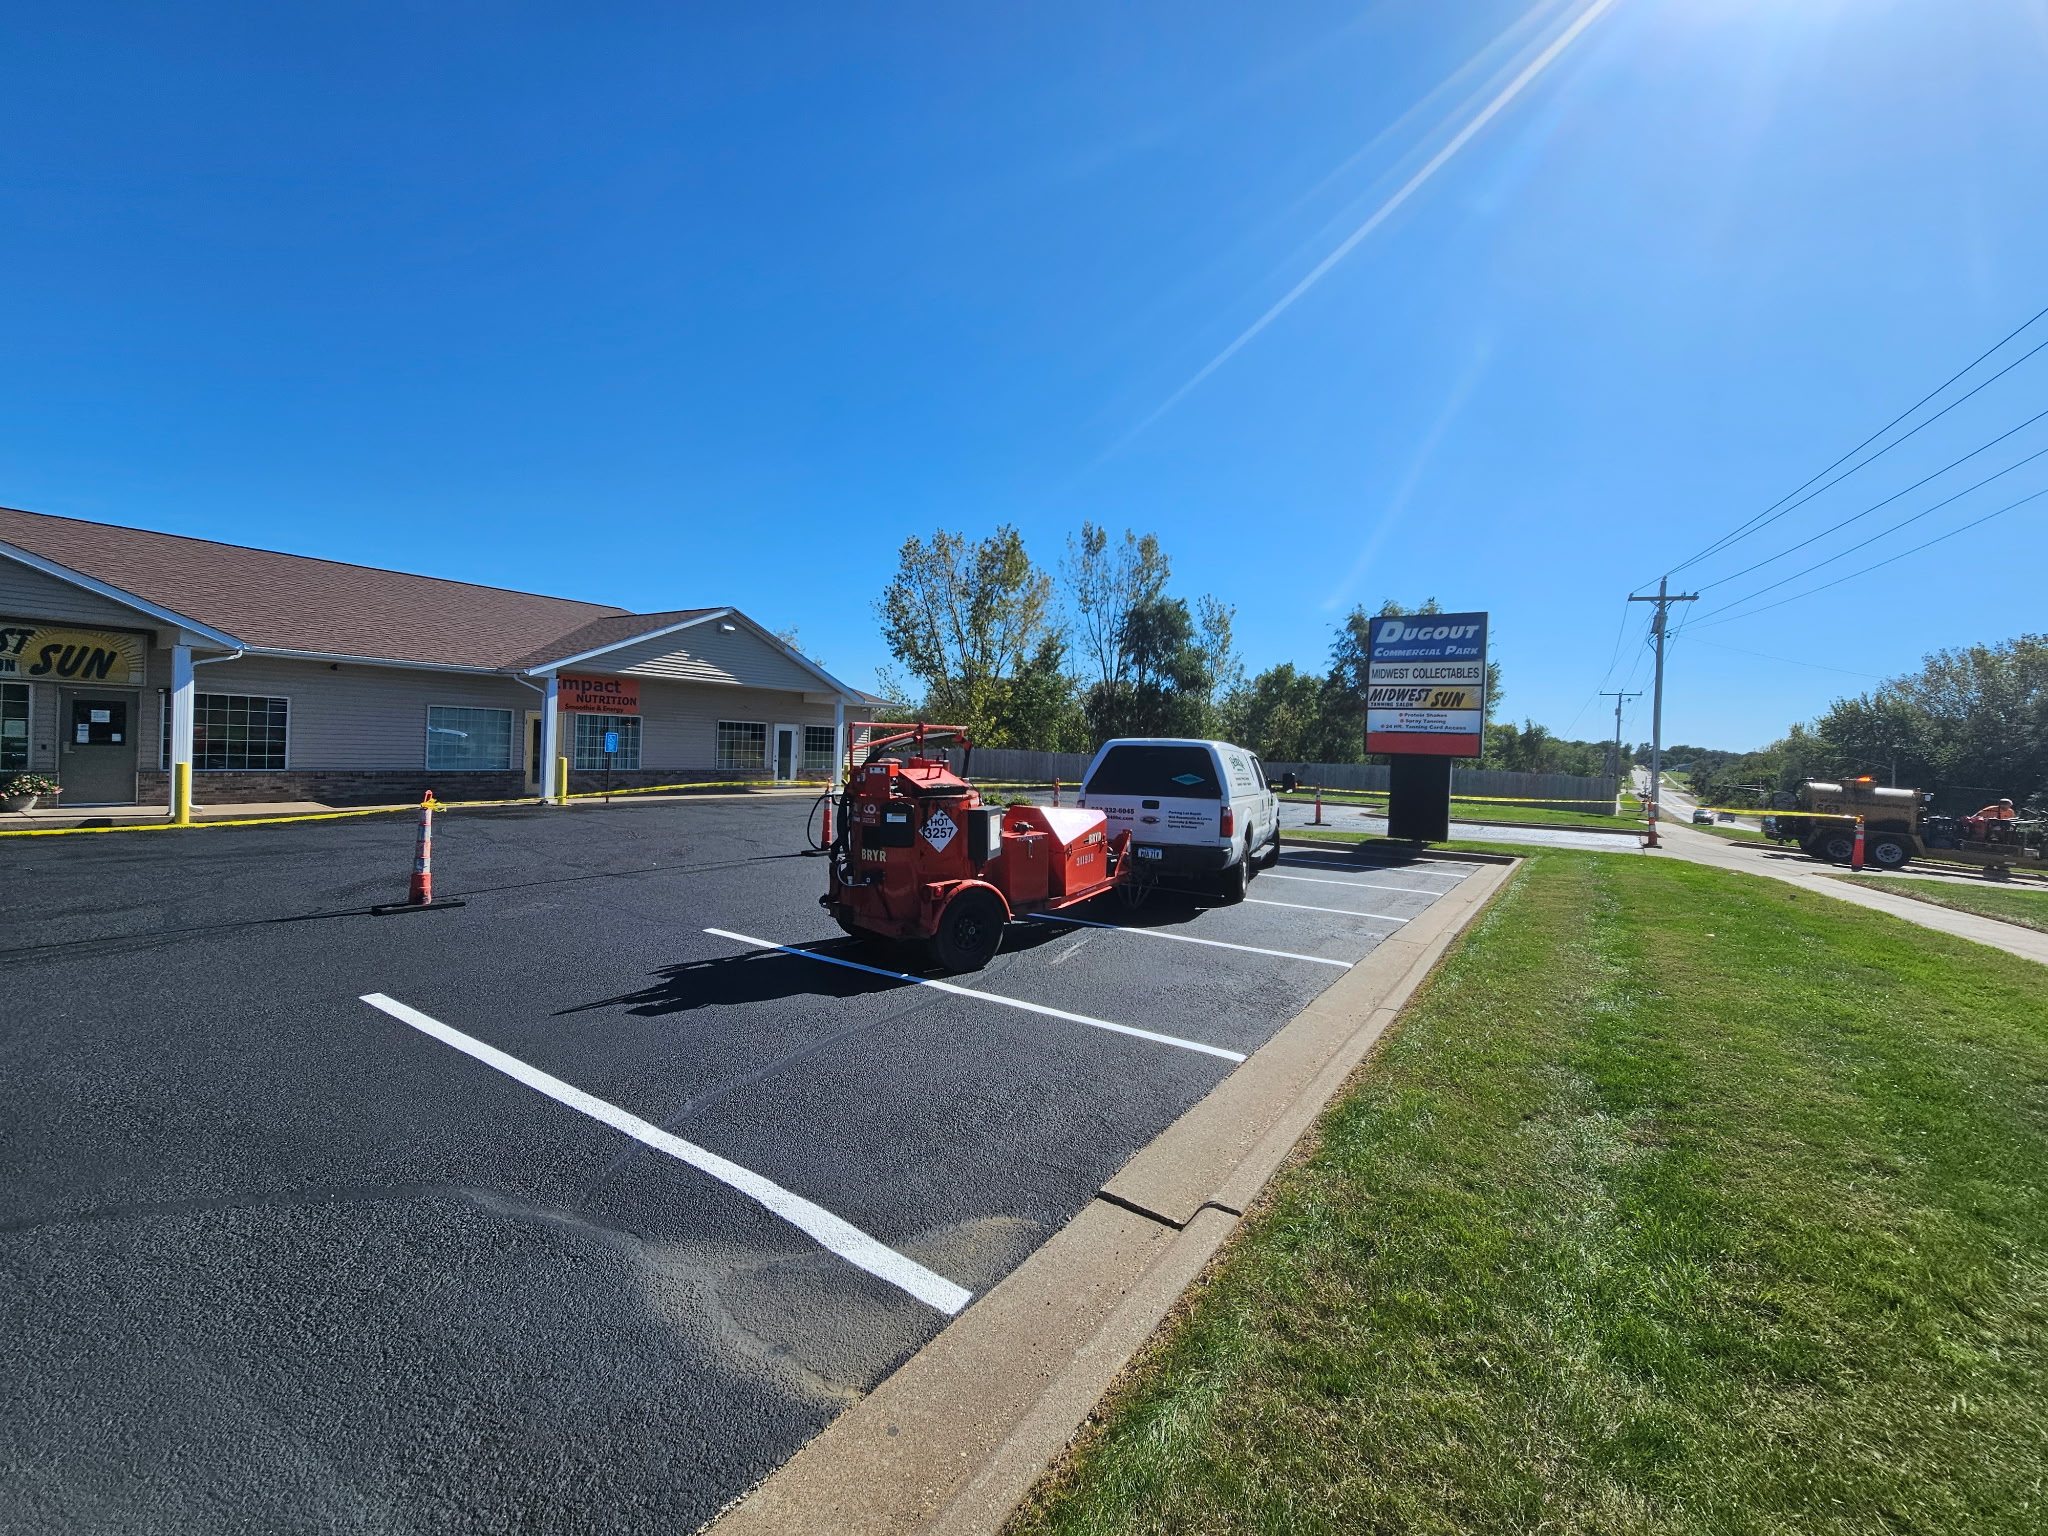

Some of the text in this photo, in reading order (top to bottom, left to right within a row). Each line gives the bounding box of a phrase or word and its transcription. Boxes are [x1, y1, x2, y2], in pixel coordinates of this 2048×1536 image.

[29, 643, 117, 680] SUN
[1372, 668, 1480, 679] MIDWEST COLLECTABLES
[558, 678, 622, 694] mpact
[576, 694, 636, 706] NUTRITION
[1369, 688, 1466, 707] MIDWEST SUN
[924, 827, 954, 839] 3257
[862, 848, 886, 862] BRYR
